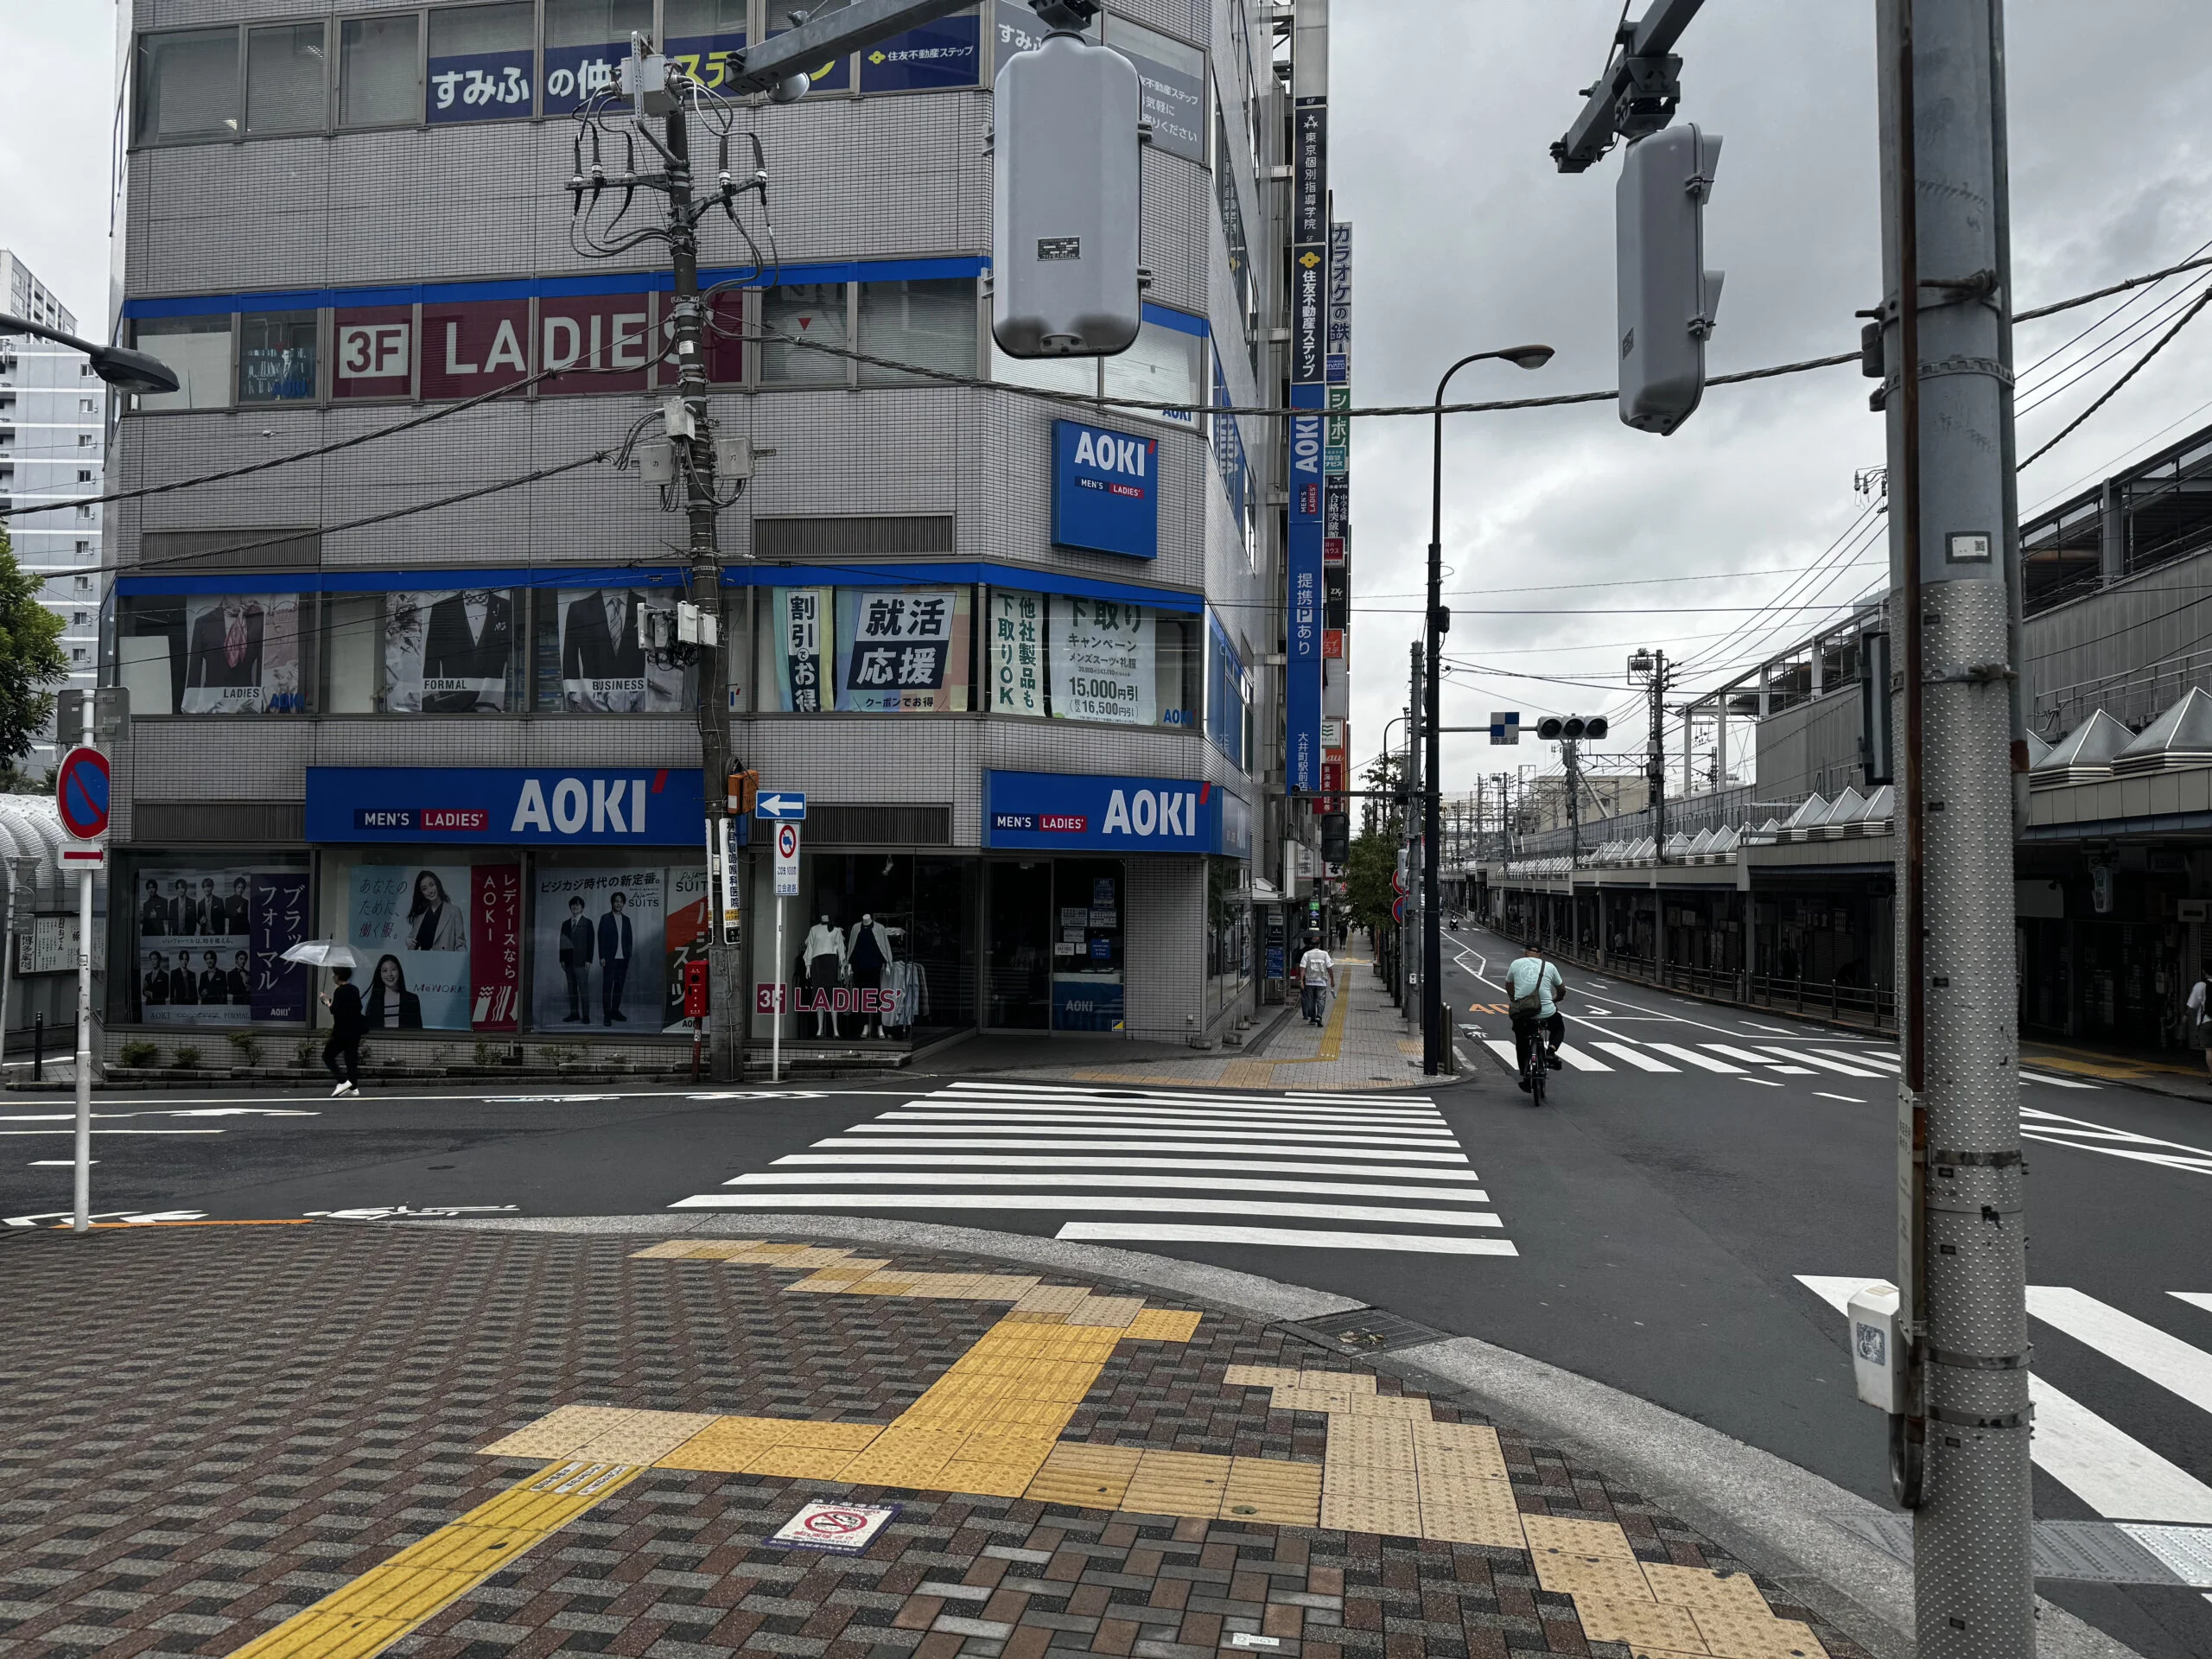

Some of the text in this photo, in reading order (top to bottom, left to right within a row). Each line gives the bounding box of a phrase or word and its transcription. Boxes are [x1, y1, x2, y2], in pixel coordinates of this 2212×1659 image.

[887, 45, 974, 62] 住友不動産ステップ
[431, 67, 531, 109] すみふ
[1304, 132, 1317, 230] 東京個別指導学院
[1302, 270, 1317, 378] 住友不動産ステップ
[346, 312, 683, 375] 3F LADIE
[1081, 479, 1141, 497] MEN'S LADIES'
[866, 599, 944, 636] 就活
[1063, 595, 1141, 633] 下取り
[1297, 573, 1313, 655] 提携Pあり
[790, 595, 816, 712] 割引でお得
[997, 594, 1015, 705] 下取りOK
[1019, 596, 1037, 709] 他社製品も
[1068, 632, 1137, 653] キャンペーン
[856, 647, 937, 685] 応援
[223, 688, 260, 699] LADIES
[423, 679, 467, 690] FORMAL
[592, 679, 645, 691] BUSINESS
[1069, 677, 1139, 702] 15,000円引
[866, 696, 934, 709] クーポンでお得
[1298, 732, 1308, 791] 大井町駅前店
[1326, 753, 1344, 763] au
[364, 812, 410, 827] MEN'S
[425, 812, 484, 828] LADIES'
[997, 816, 1032, 828] MEN'S
[1042, 817, 1084, 830] LADIES'
[359, 877, 408, 894] あなたの
[541, 873, 660, 893] ビジカジ時代の新定番。
[676, 881, 708, 893] SUIT
[359, 900, 400, 917] ために、
[483, 876, 497, 942] AOKI
[628, 899, 659, 907] SUITS
[359, 923, 398, 940] 働く服。
[503, 874, 517, 979] レディースなら
[257, 886, 279, 991] フォーマル
[794, 987, 902, 1013] LADIES'
[1065, 1000, 1094, 1012] AOKI
